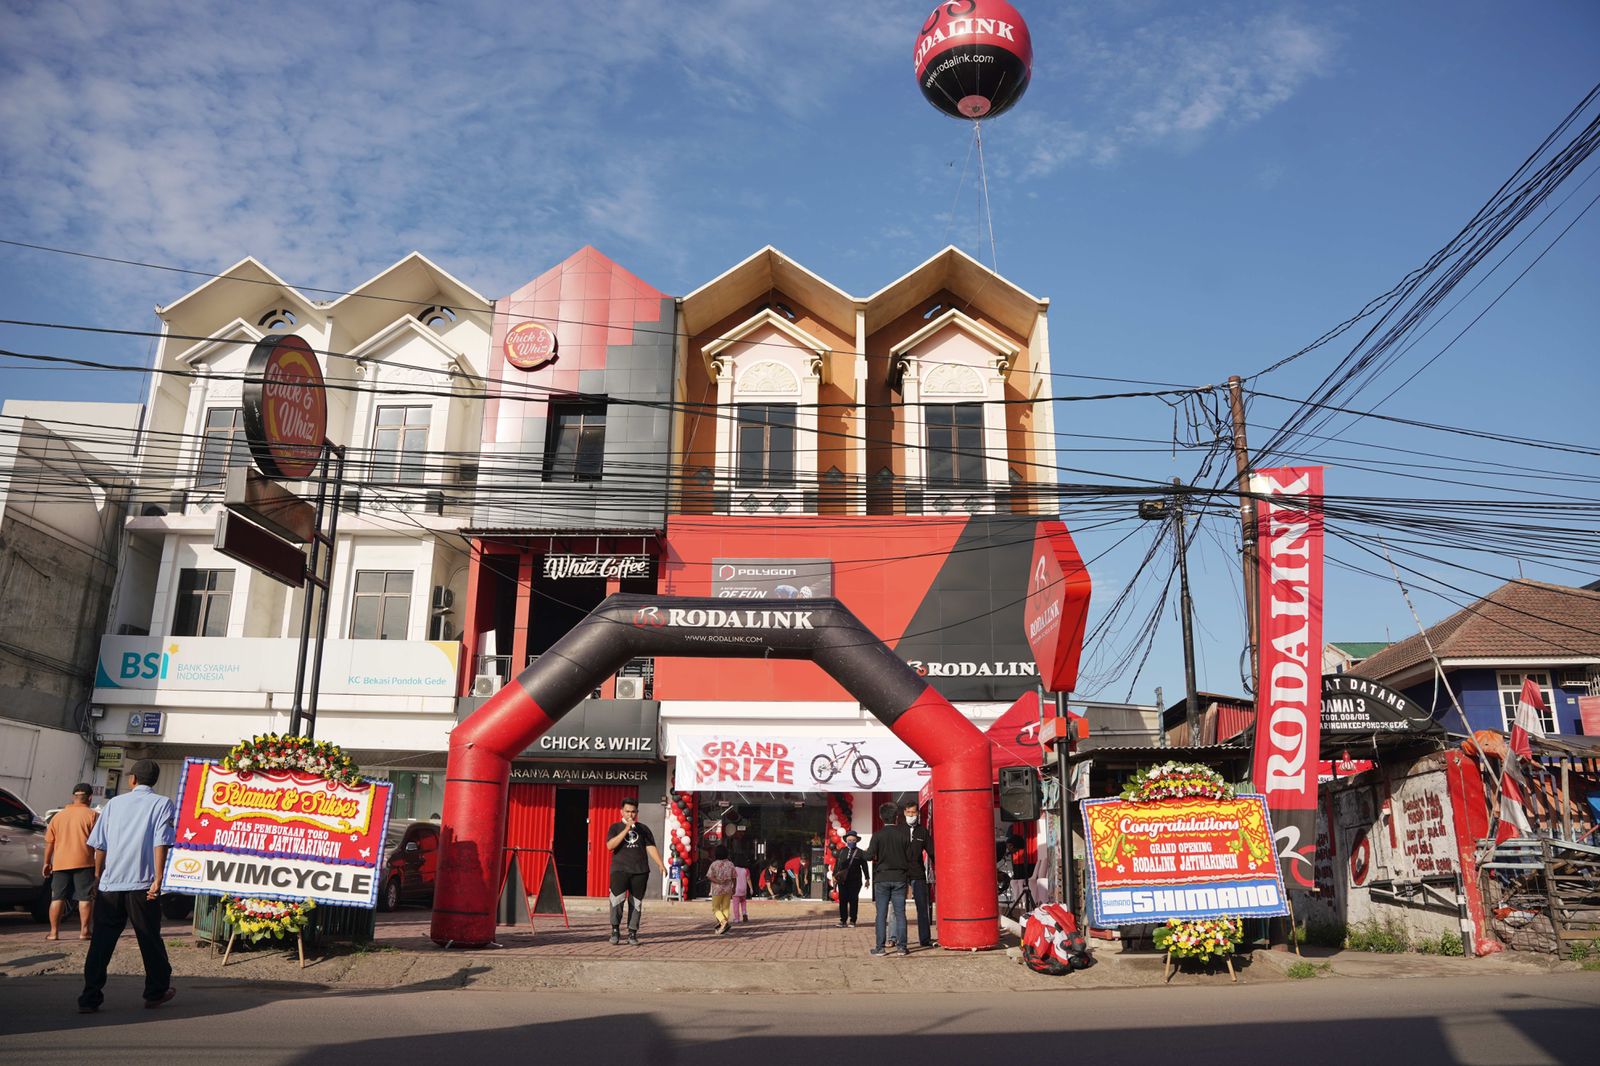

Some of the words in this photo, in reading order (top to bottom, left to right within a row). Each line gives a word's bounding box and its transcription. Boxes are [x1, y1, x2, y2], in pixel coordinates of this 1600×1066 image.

[915, 18, 1014, 73] ODALINK
[925, 53, 994, 88] www.rodalink.com
[546, 556, 598, 580] Whiz
[599, 557, 646, 579] Coffee
[738, 568, 797, 576] POLYGON
[668, 609, 814, 630] RODALINK
[1030, 600, 1060, 640] RODALINK
[685, 635, 763, 643] WWW.RODALINK.COM
[1266, 472, 1310, 794] RODALINK
[120, 652, 170, 680] BSI
[203, 665, 240, 673] SYARIAH
[927, 661, 1042, 677] RODALIN
[177, 673, 225, 681] INDONESIA
[348, 676, 361, 685] KC
[363, 676, 390, 685] Bekasi
[392, 677, 423, 686] Pondok
[425, 678, 447, 686] Gede
[1321, 679, 1341, 692] AT
[1350, 679, 1406, 711] DATANG
[1357, 699, 1366, 712] 3
[541, 736, 590, 750] CHICK
[594, 736, 606, 749] &
[608, 737, 652, 751] WHIZ
[703, 741, 788, 759] GRAND
[509, 769, 549, 778] ARANYA
[552, 770, 579, 779] AYAM
[581, 771, 603, 779] DAN
[605, 771, 648, 780] BURGER
[696, 758, 794, 784] PRIZE
[214, 782, 281, 809] Selamat
[281, 788, 299, 810] &
[301, 791, 358, 818] Sukses
[231, 821, 252, 831] ATAS
[254, 823, 305, 837] PEMBUKAAN
[307, 829, 329, 840] TOKO
[1120, 817, 1239, 837] Congratulations
[213, 829, 267, 850] RODALINK
[268, 836, 341, 858] JATIWARINGIN
[1150, 844, 1176, 854] GRAND
[1178, 842, 1212, 853] OPENING
[1132, 857, 1176, 872] RODALINK
[1179, 854, 1238, 871] JATIWARINGIN
[206, 860, 372, 895] WIMCYCLE
[1132, 885, 1279, 912] SHIMANO
